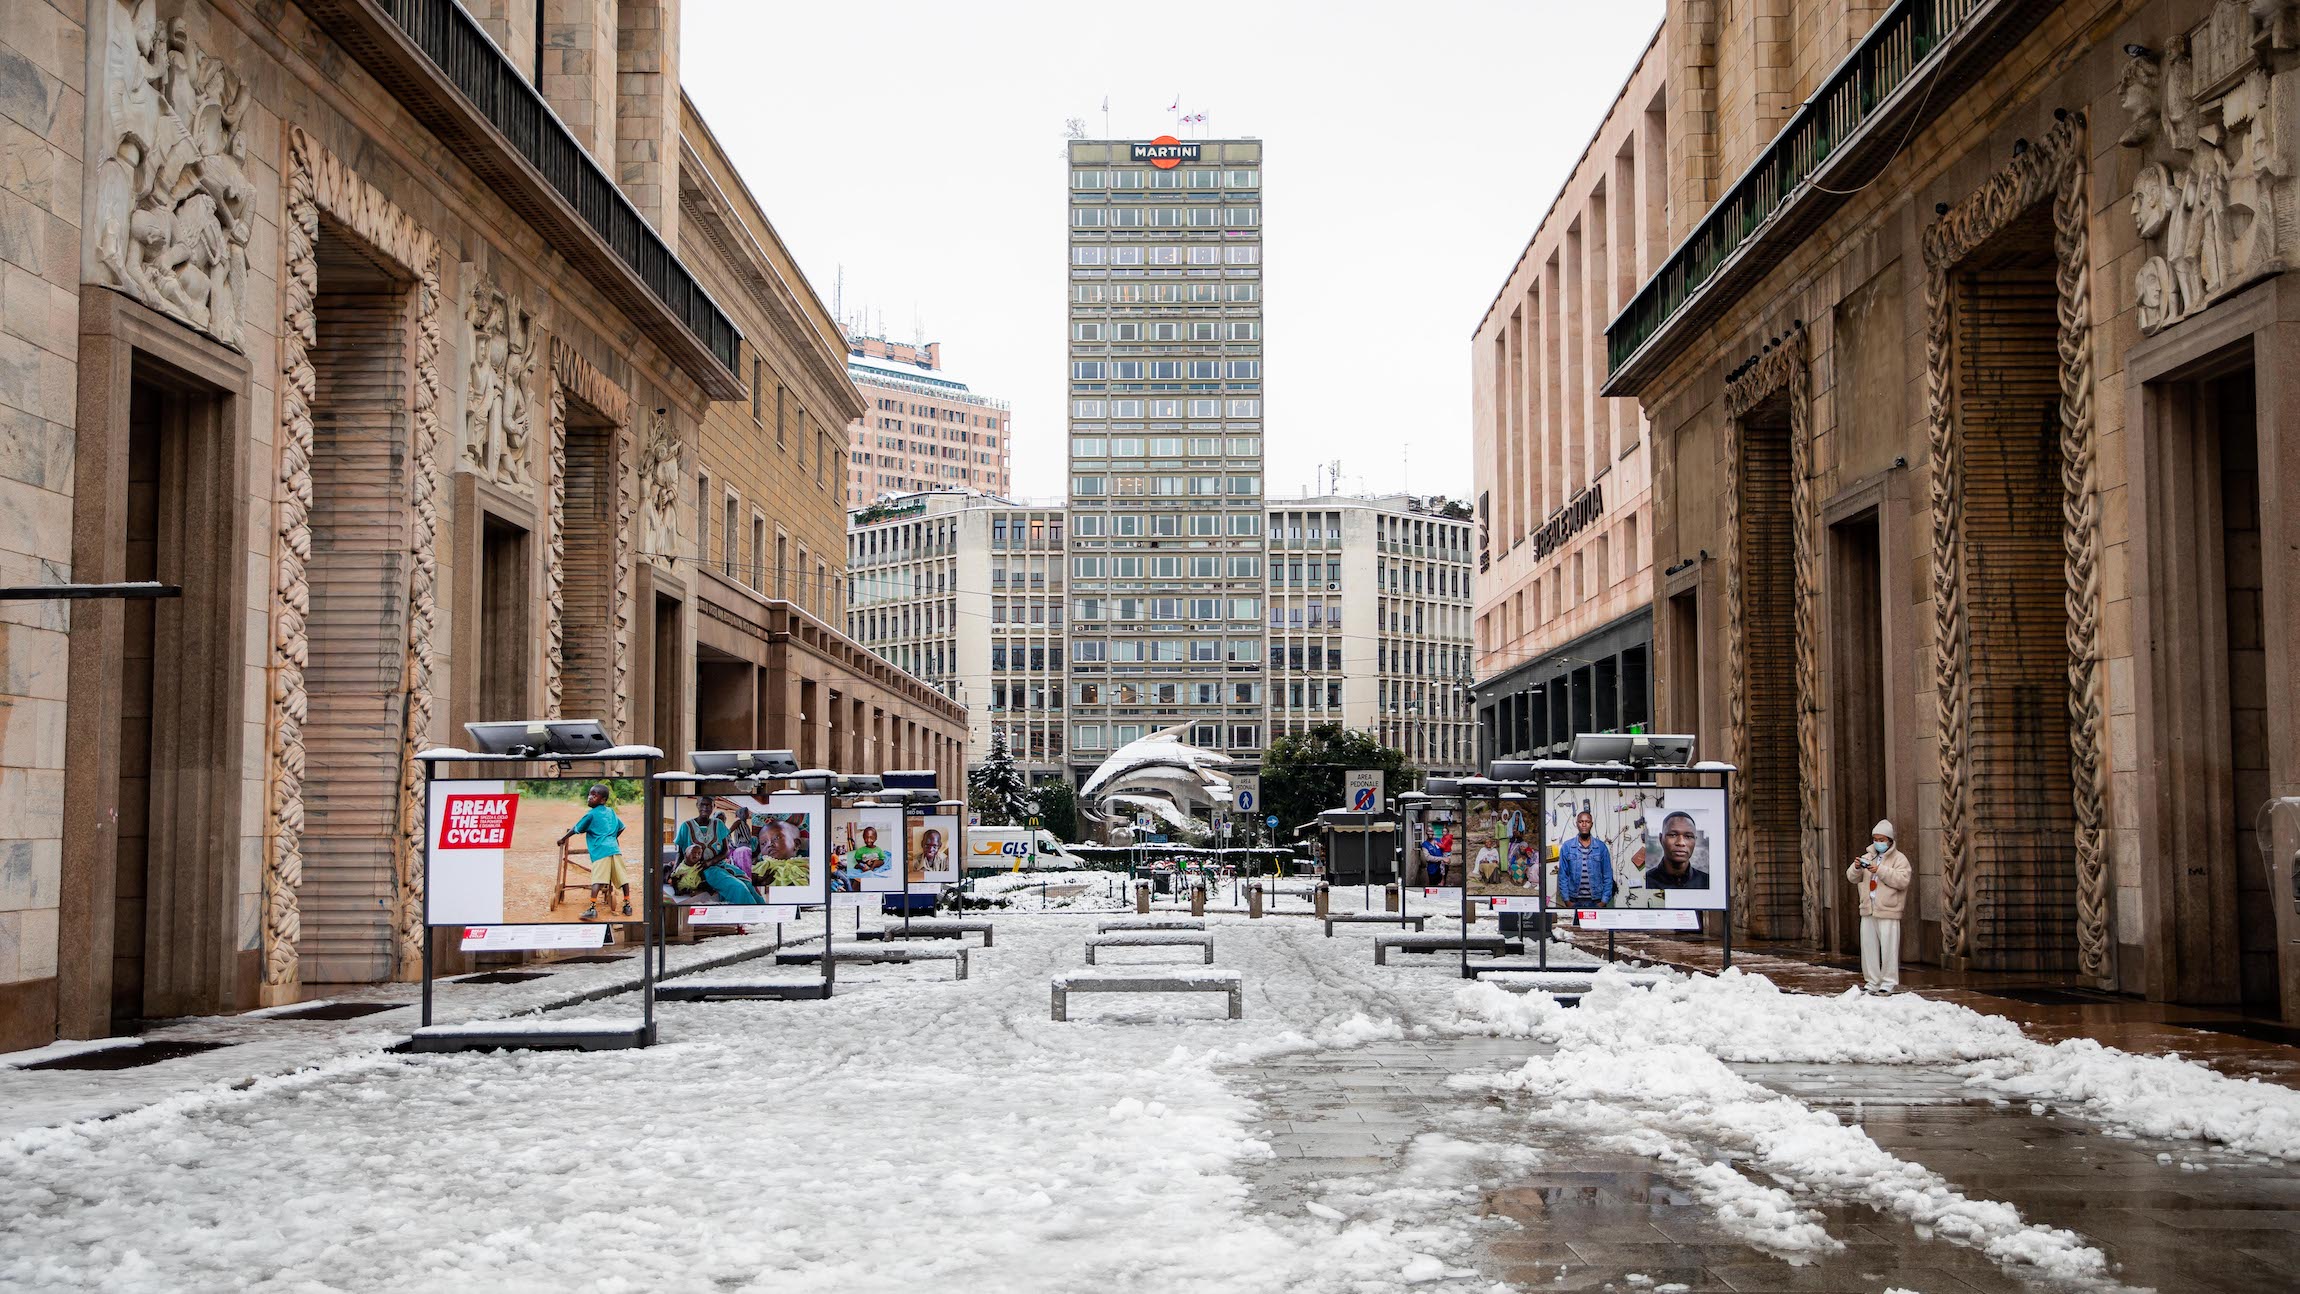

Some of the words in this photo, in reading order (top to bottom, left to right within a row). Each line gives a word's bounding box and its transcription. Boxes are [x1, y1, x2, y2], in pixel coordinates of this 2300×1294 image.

[1135, 146, 1197, 157] MARTINI
[1350, 780, 1379, 788] PEDONALE
[451, 799, 510, 815] BREAK
[450, 815, 478, 828] THE
[447, 828, 505, 844] CYCLE!
[1002, 841, 1029, 855] GLS
